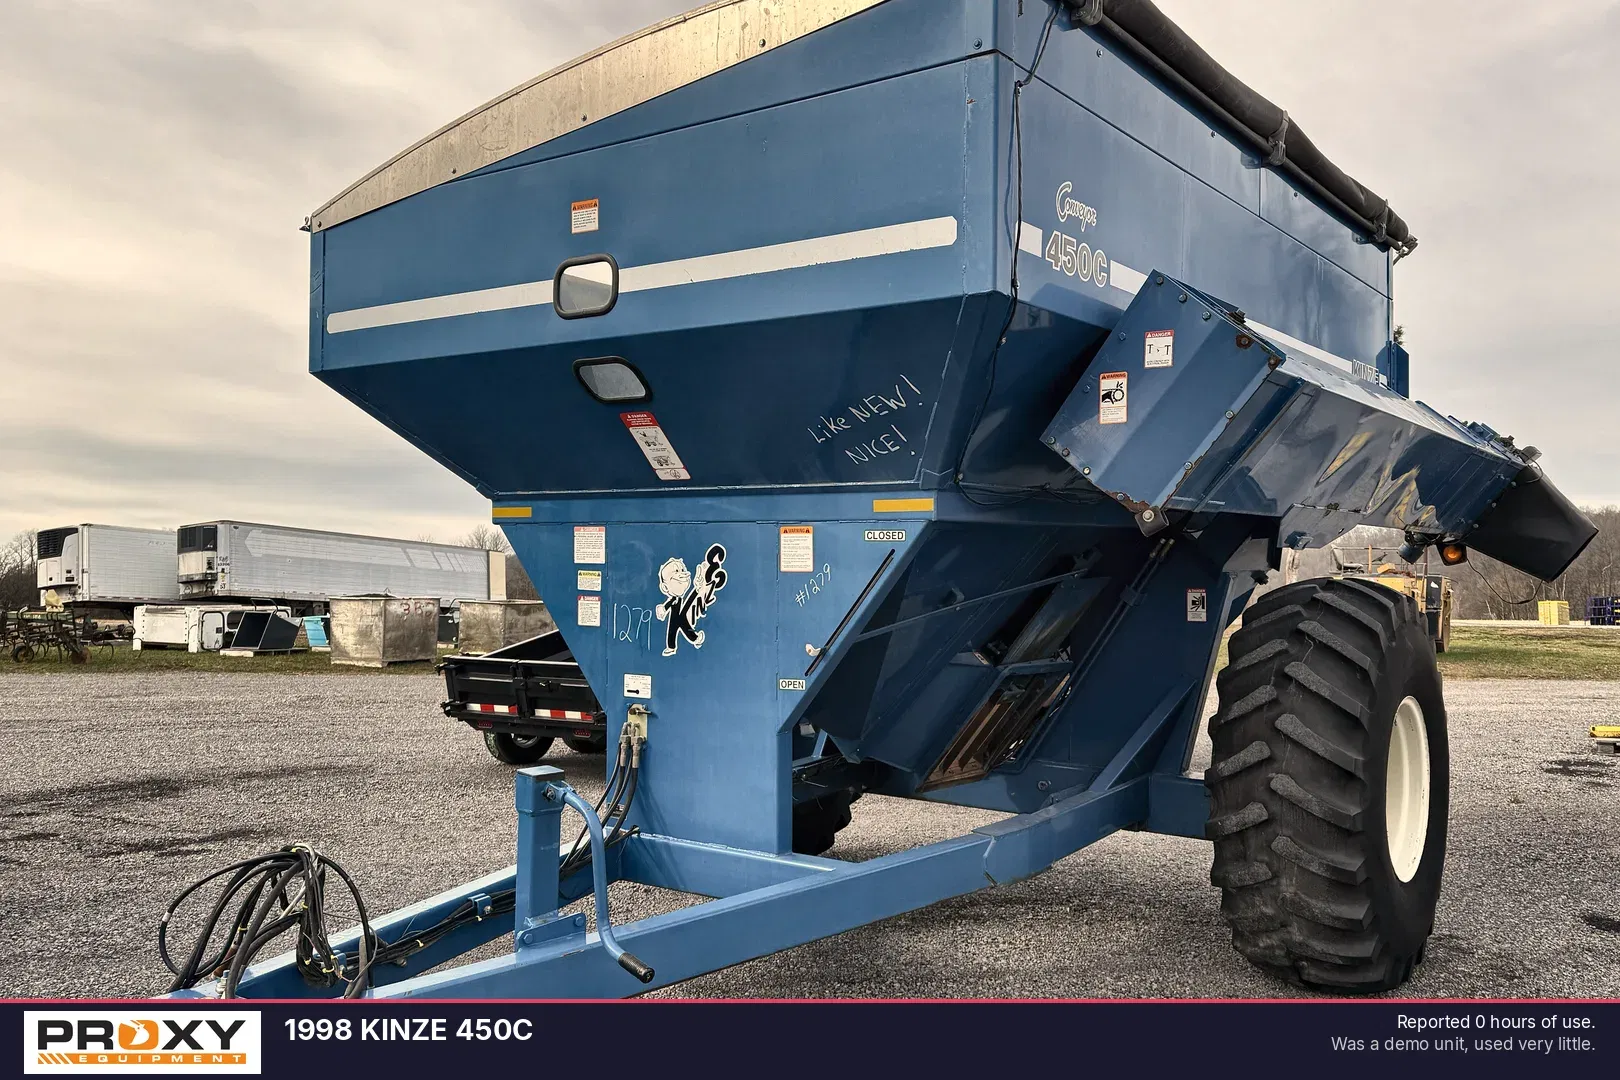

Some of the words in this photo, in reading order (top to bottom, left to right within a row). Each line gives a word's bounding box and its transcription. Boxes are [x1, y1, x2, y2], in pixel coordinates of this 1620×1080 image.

[1055, 181, 1098, 232] Conveyor
[1045, 230, 1108, 288] 450C
[844, 424, 916, 465] NICE!
[866, 531, 904, 540] CLOSED
[794, 563, 833, 608] #1279
[613, 603, 653, 651] 1279
[780, 680, 804, 690] OPEN
